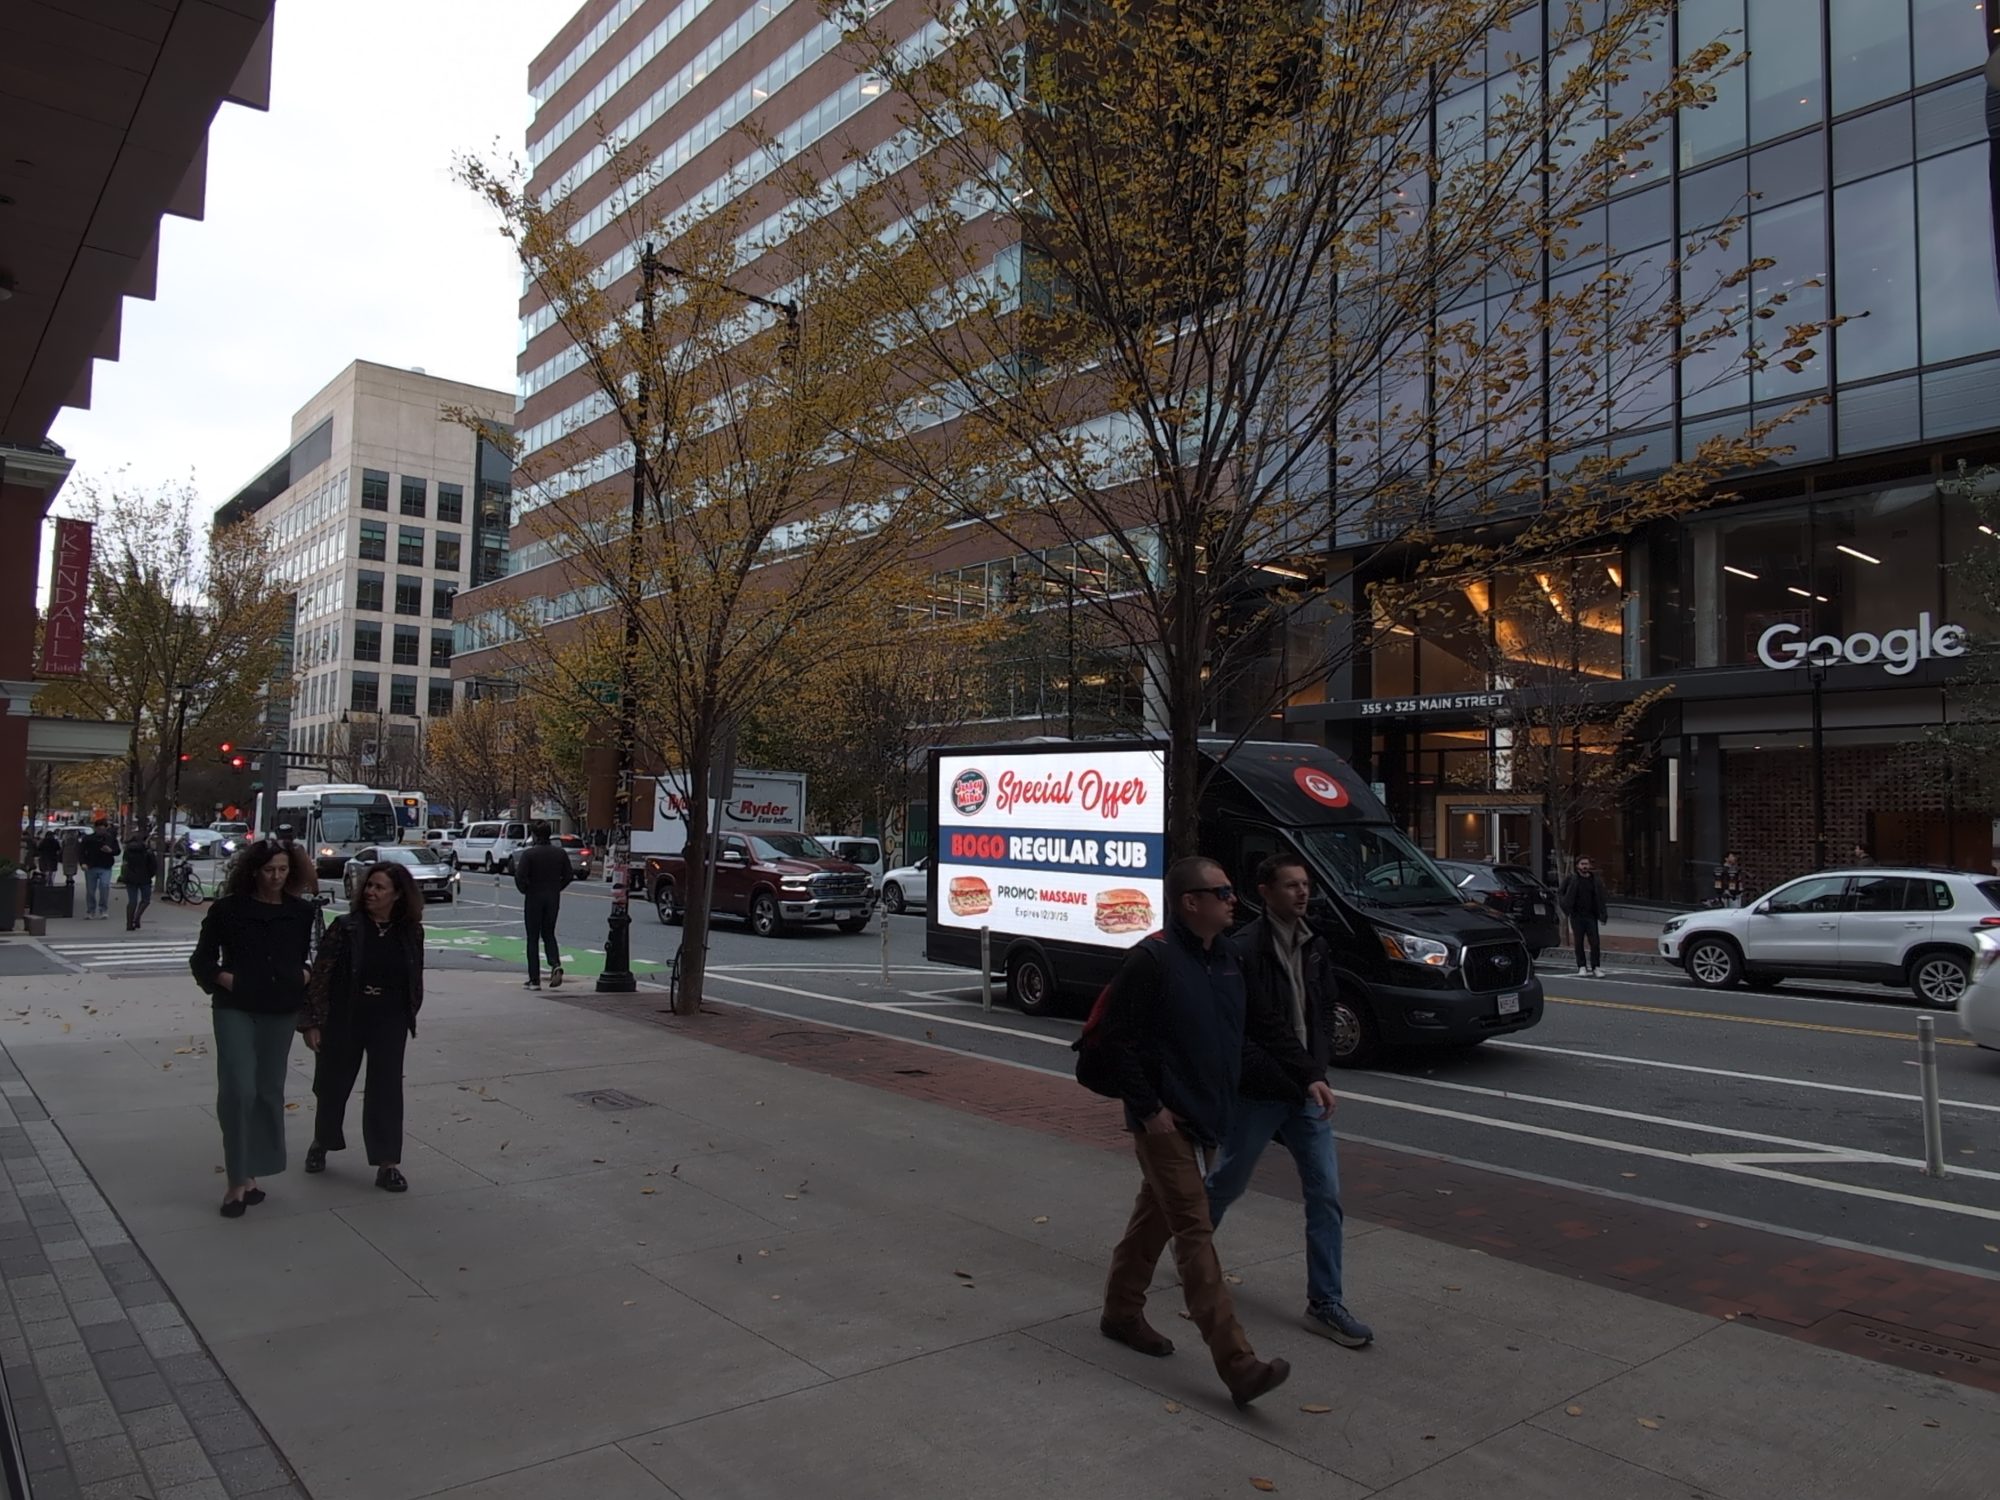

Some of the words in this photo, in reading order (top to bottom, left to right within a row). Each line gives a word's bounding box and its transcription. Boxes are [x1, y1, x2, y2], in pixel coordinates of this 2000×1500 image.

[52, 533, 81, 658] KENDALL
[1757, 612, 1967, 676] Google
[45, 661, 78, 672] Hotel
[1361, 703, 1382, 715] 355
[1394, 701, 1416, 712] 325
[1419, 698, 1452, 711] MAIN
[1454, 694, 1504, 708] STREET
[996, 770, 1073, 815] Special
[1078, 769, 1147, 819] Offer
[740, 800, 789, 817] Ryder
[951, 833, 1005, 859] BOGO
[1009, 835, 1099, 866] REGULAR
[1104, 840, 1147, 868] SUB
[998, 885, 1038, 901] PROMO:
[1039, 889, 1088, 905] MASSAVE
[1015, 906, 1040, 918] Expires
[1865, 1330, 1982, 1364] ELECTRIC
